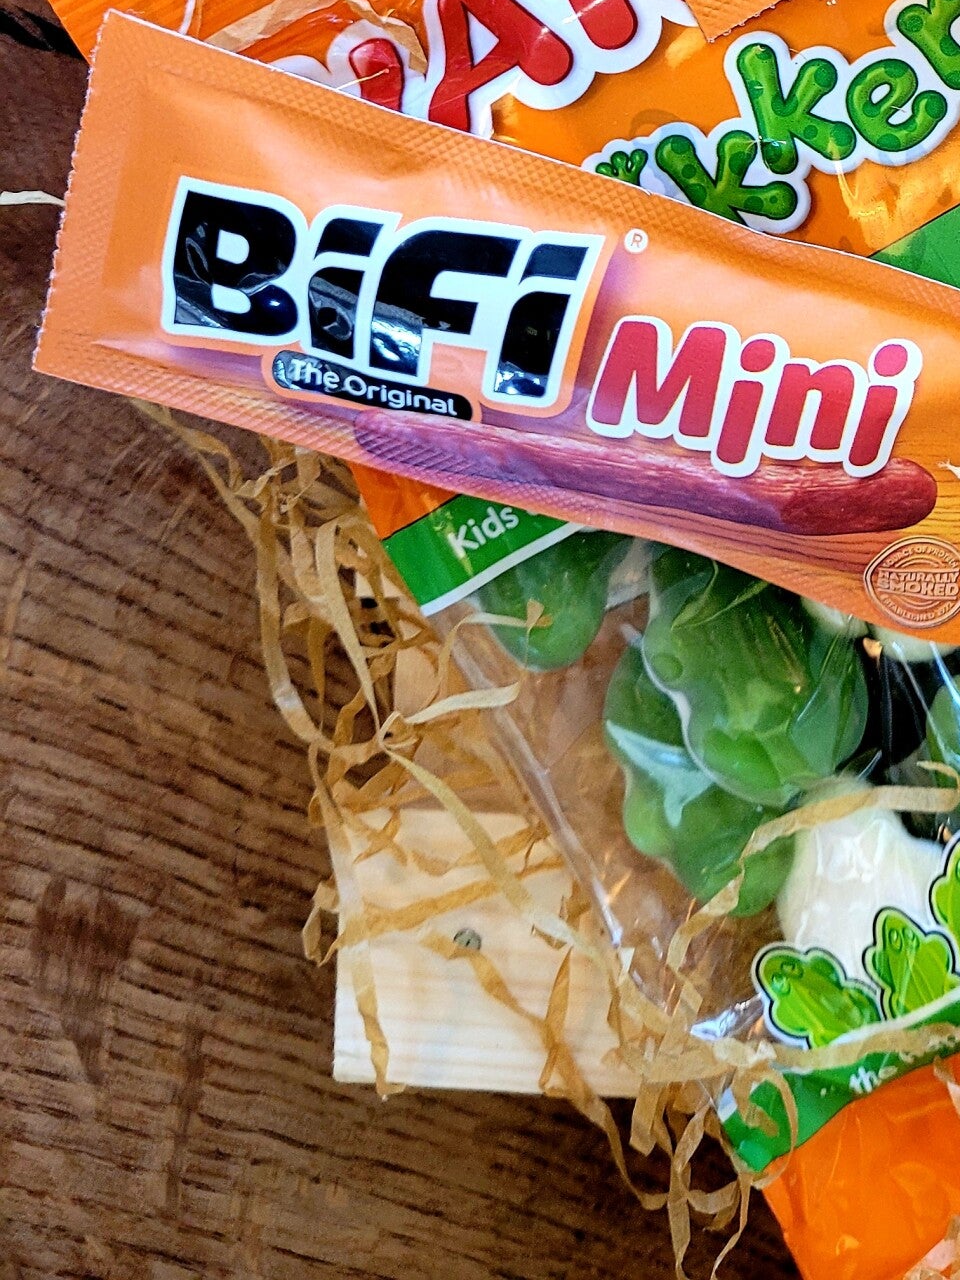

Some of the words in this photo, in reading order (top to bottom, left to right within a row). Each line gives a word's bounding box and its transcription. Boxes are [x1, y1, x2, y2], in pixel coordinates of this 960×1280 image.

[164, 178, 603, 405] BiFi
[291, 358, 341, 393] The
[343, 375, 458, 417] Original
[588, 317, 920, 476] Mini
[447, 505, 520, 559] Kids
[878, 579, 960, 596] SMOKED
[879, 571, 960, 584] NATURALLY
